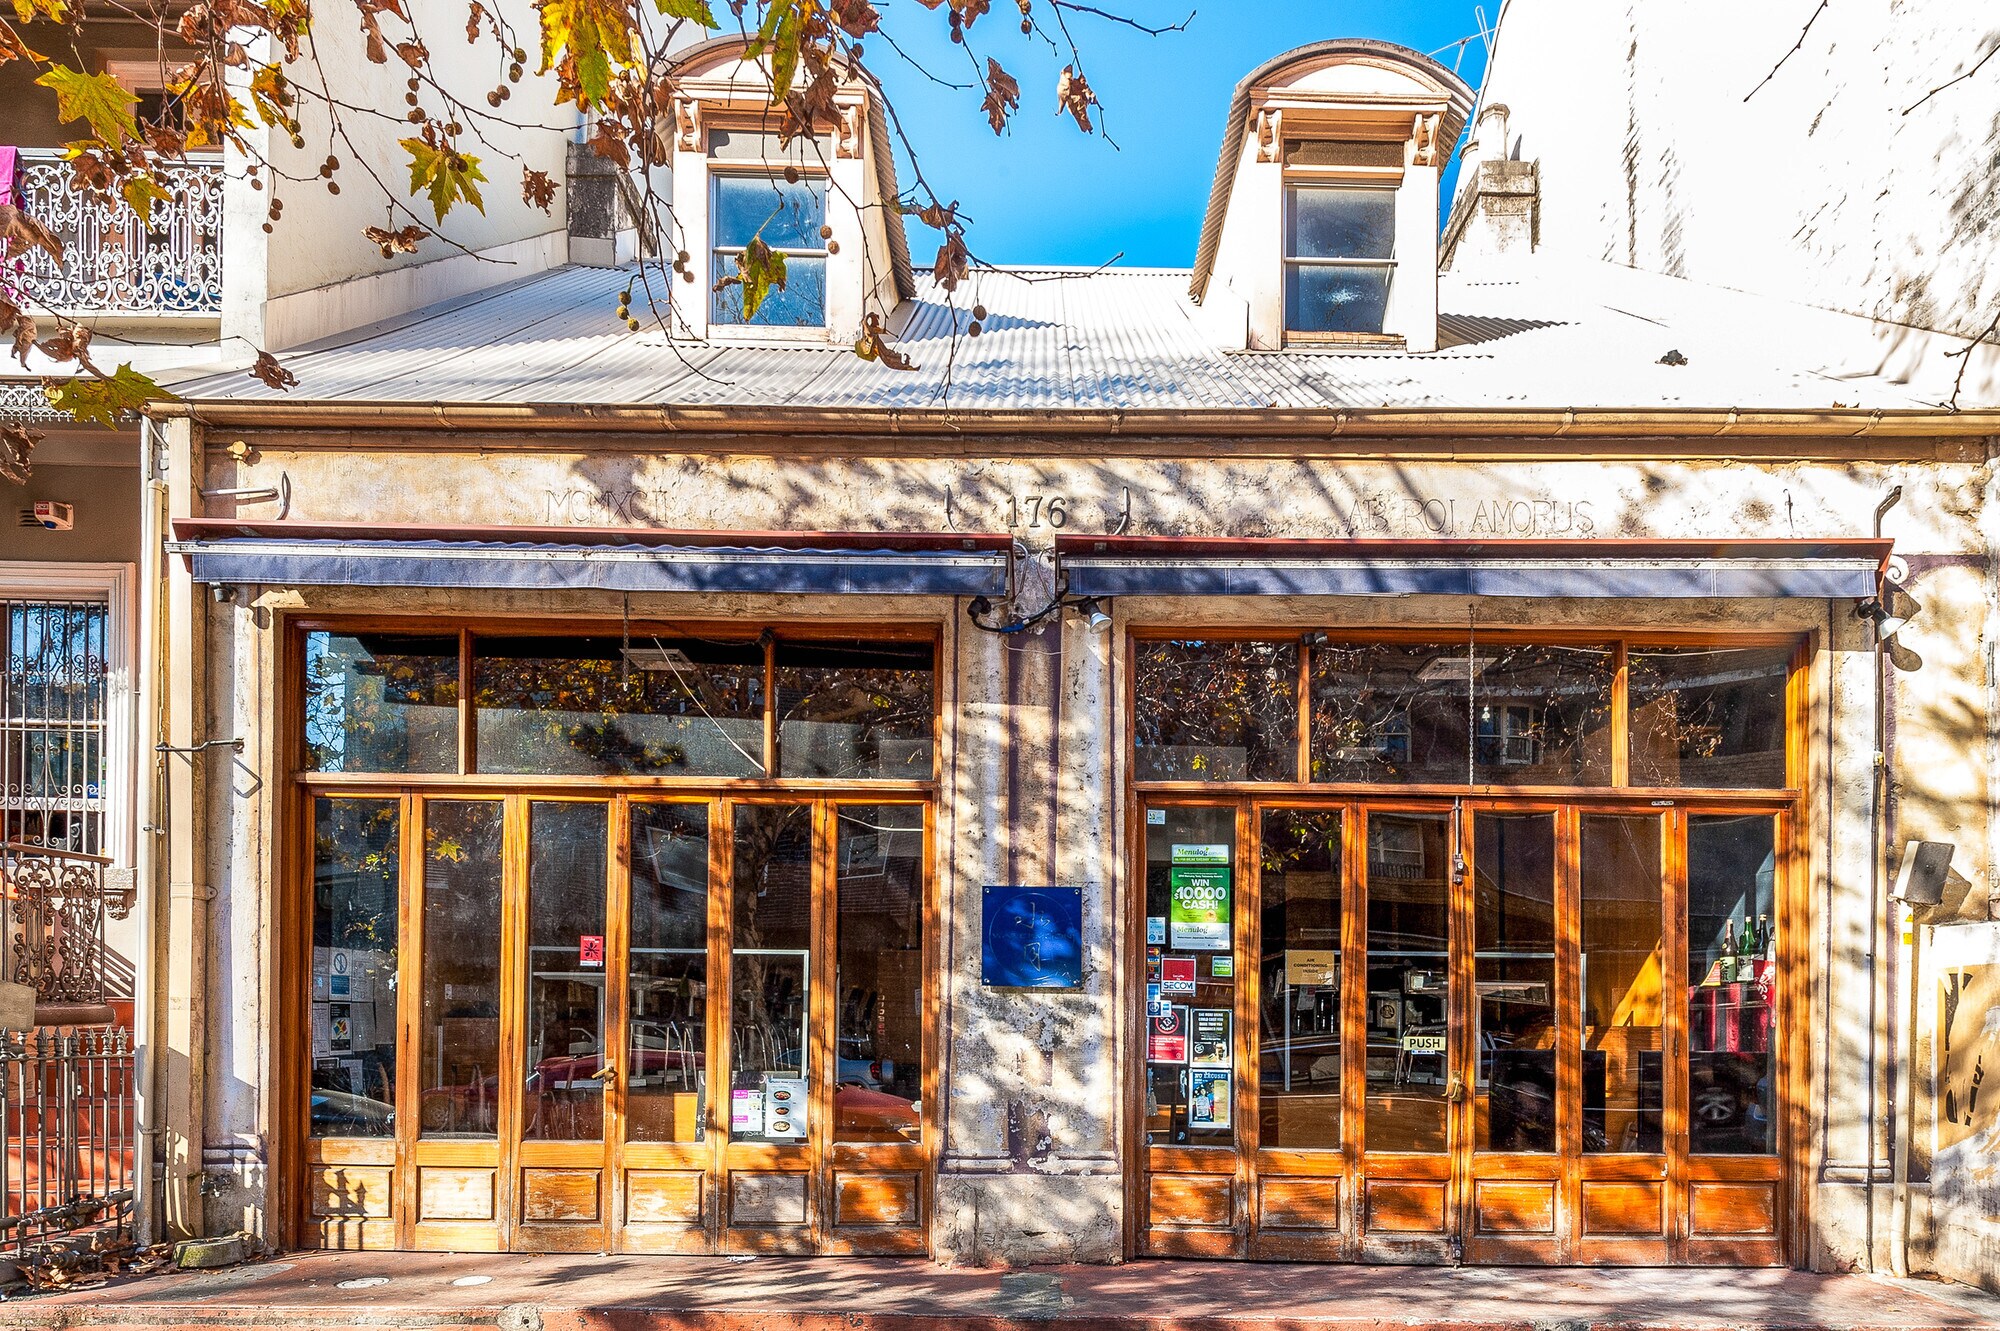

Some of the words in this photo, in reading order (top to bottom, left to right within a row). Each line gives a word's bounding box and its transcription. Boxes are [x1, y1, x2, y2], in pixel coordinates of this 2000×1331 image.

[1006, 494, 1067, 529] 176
[1191, 879, 1210, 887] WIN
[1182, 900, 1219, 910] CASH!
[1163, 982, 1194, 990] SECOM
[1409, 1038, 1440, 1048] PUSH
